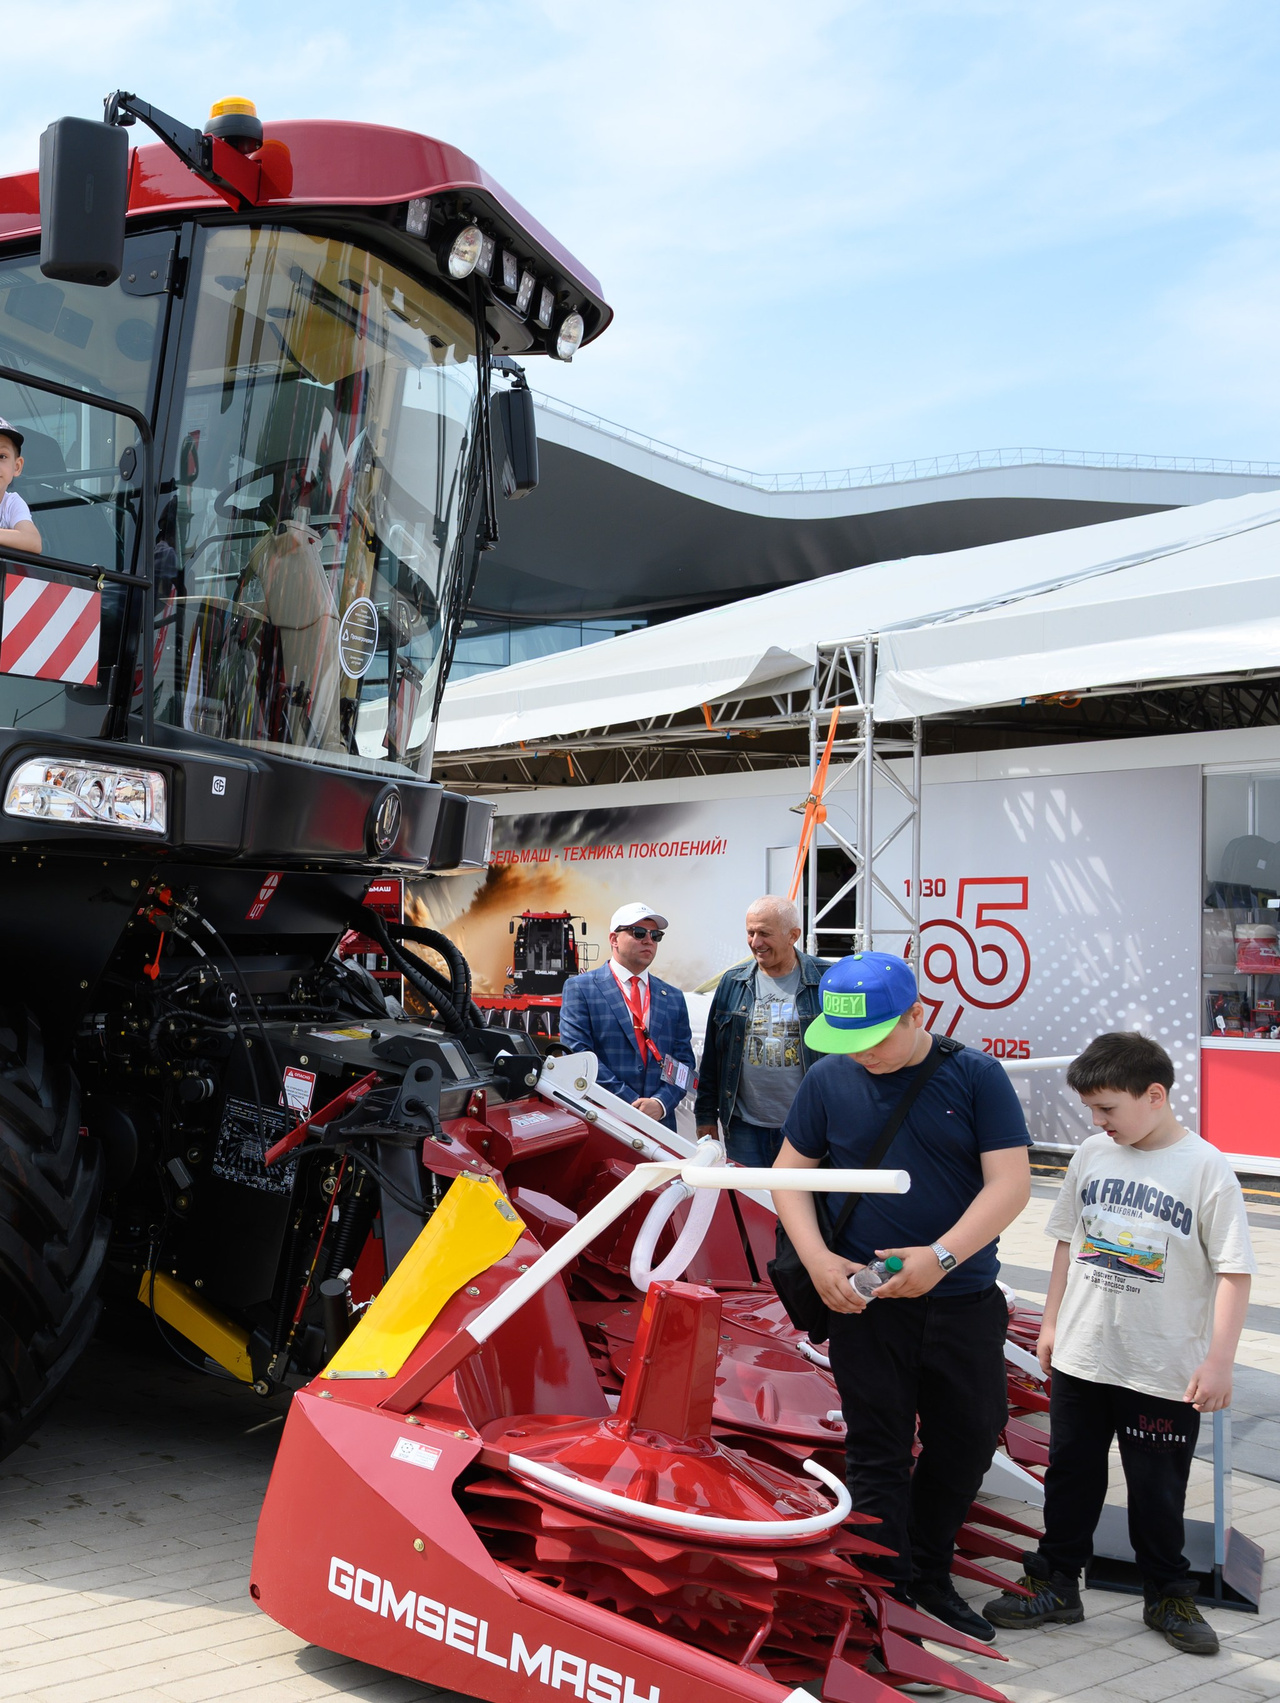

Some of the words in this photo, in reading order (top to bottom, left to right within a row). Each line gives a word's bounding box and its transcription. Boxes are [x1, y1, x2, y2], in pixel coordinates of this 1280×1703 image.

[563, 844, 624, 862] ТЕХНИКА
[628, 835, 728, 859] ПОКОЛЕНИЙ!
[903, 878, 947, 897] 130
[824, 994, 861, 1015] OBEY
[981, 1037, 1031, 1060] 2025
[1100, 1178, 1193, 1236] FRANCISCO
[1102, 1203, 1143, 1220] CALIFORNIA
[1139, 1414, 1174, 1433] BACK
[1126, 1426, 1156, 1441] DON'T
[1162, 1433, 1187, 1443] LOOK
[327, 1556, 661, 1703] GOMSELMASH
